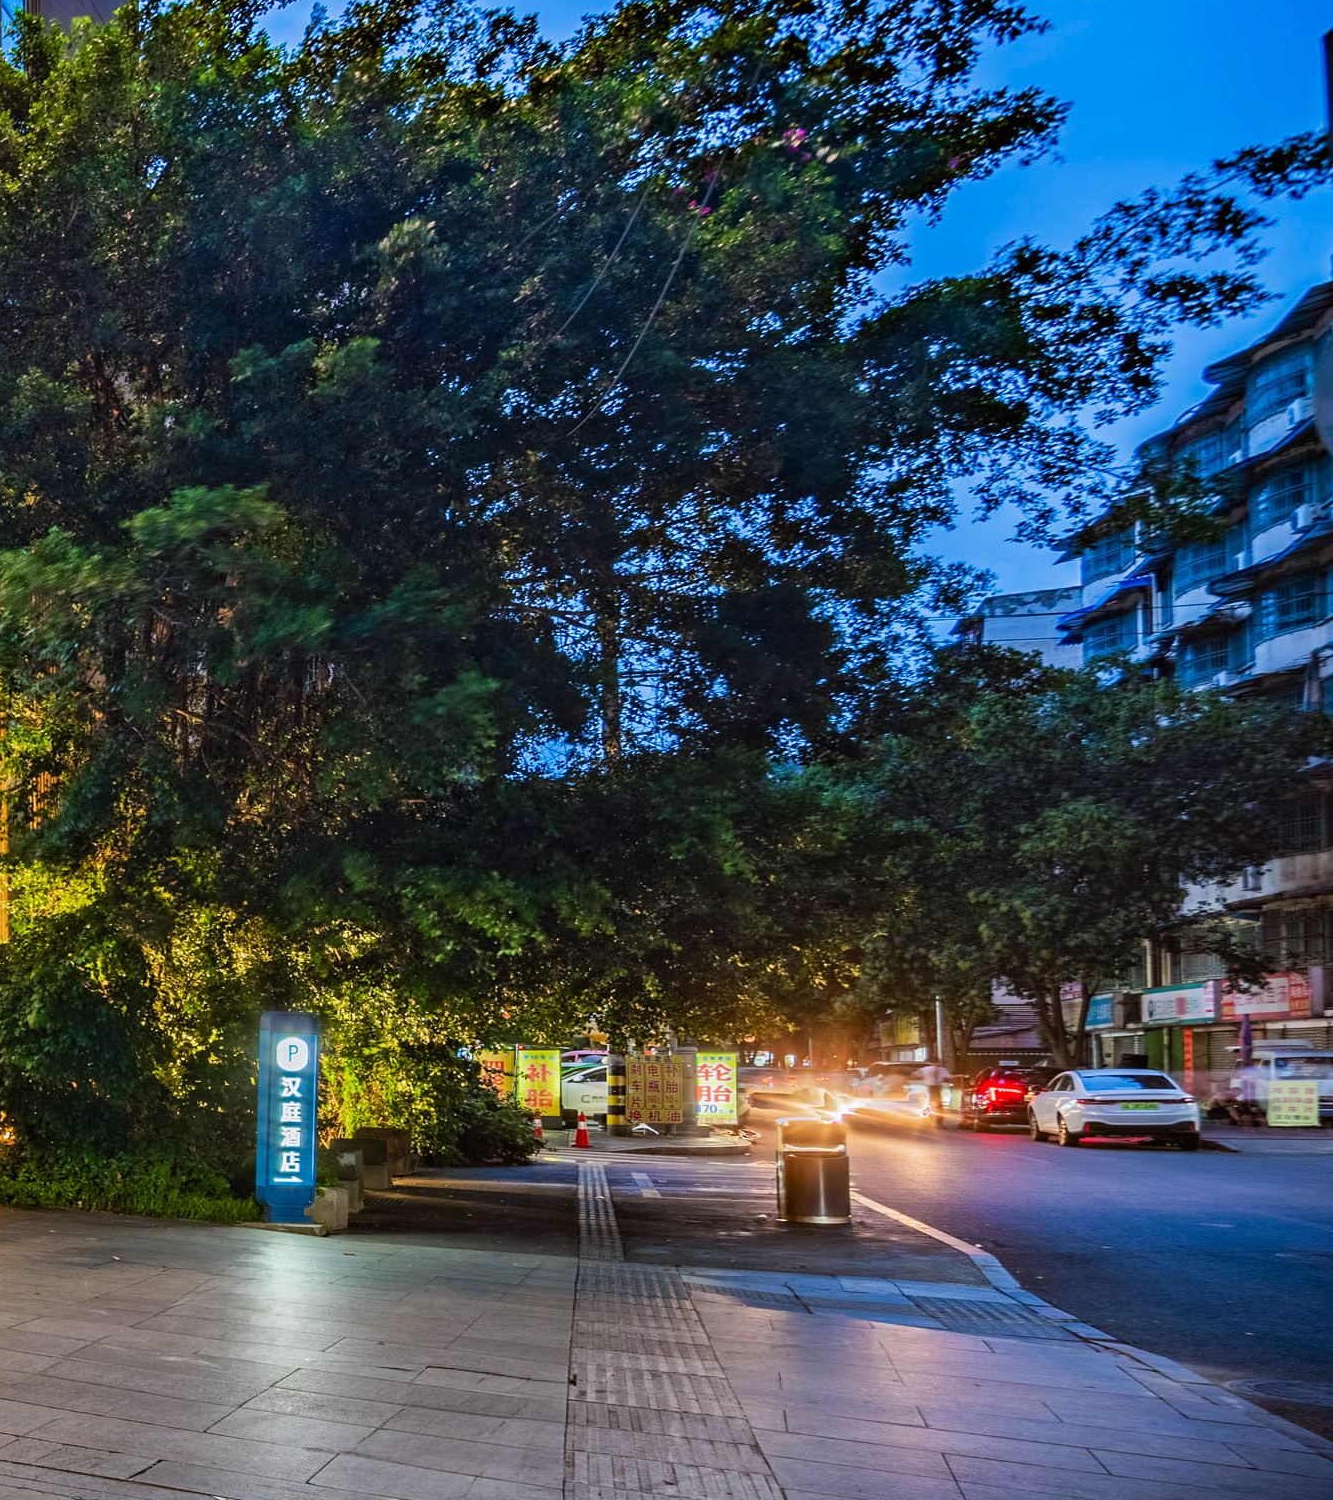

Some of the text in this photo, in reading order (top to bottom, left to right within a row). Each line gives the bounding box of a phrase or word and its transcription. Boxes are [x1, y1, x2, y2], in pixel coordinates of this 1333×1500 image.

[288, 1044, 299, 1063] P
[526, 1063, 554, 1108] 补胎
[648, 1064, 661, 1093] 电瓶
[665, 1064, 678, 1093] 补胎
[695, 1063, 733, 1103] 轮胎
[280, 1077, 303, 1173] 汉庭酒店
[628, 1109, 681, 1122] 换机油
